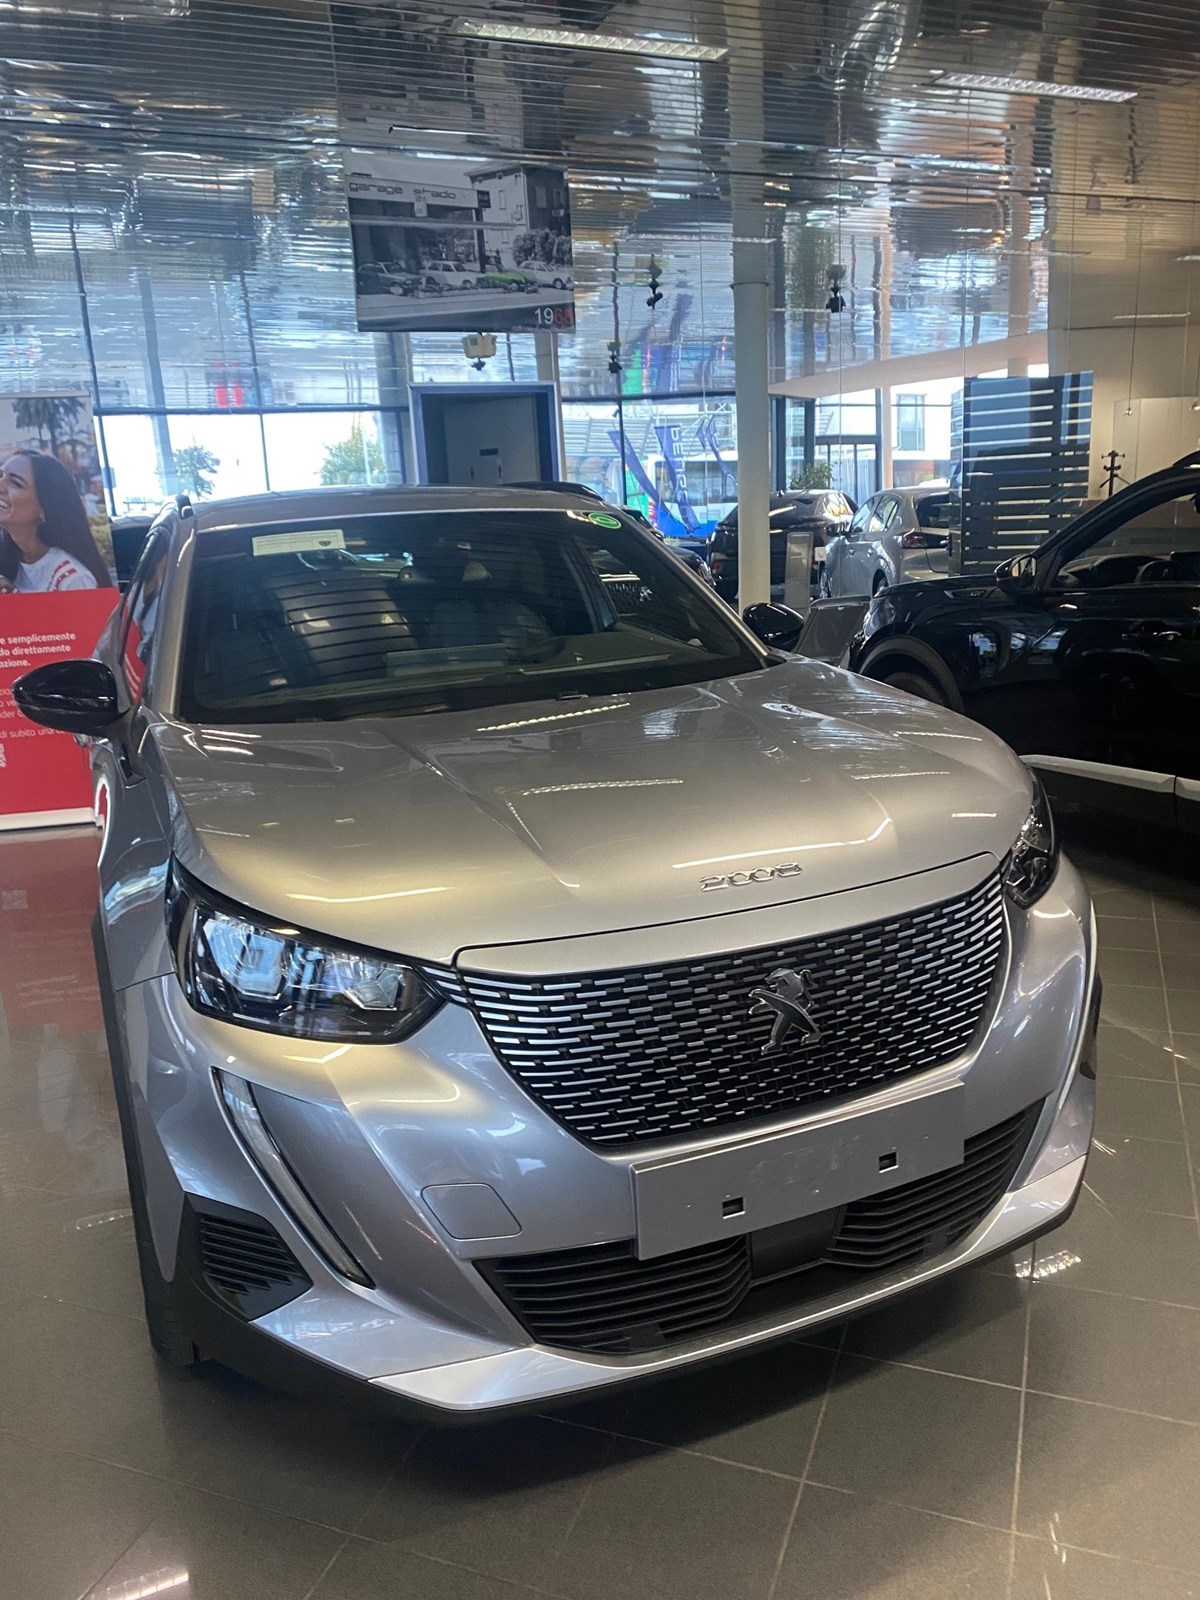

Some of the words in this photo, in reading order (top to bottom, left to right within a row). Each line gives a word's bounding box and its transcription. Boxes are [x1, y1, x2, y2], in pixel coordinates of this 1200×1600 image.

[349, 182, 403, 195] garage
[534, 306, 573, 324] 1968
[8, 633, 76, 645] semplicemente
[12, 645, 71, 656] direttamente
[9, 728, 36, 738] subito
[699, 862, 802, 891] 2008
